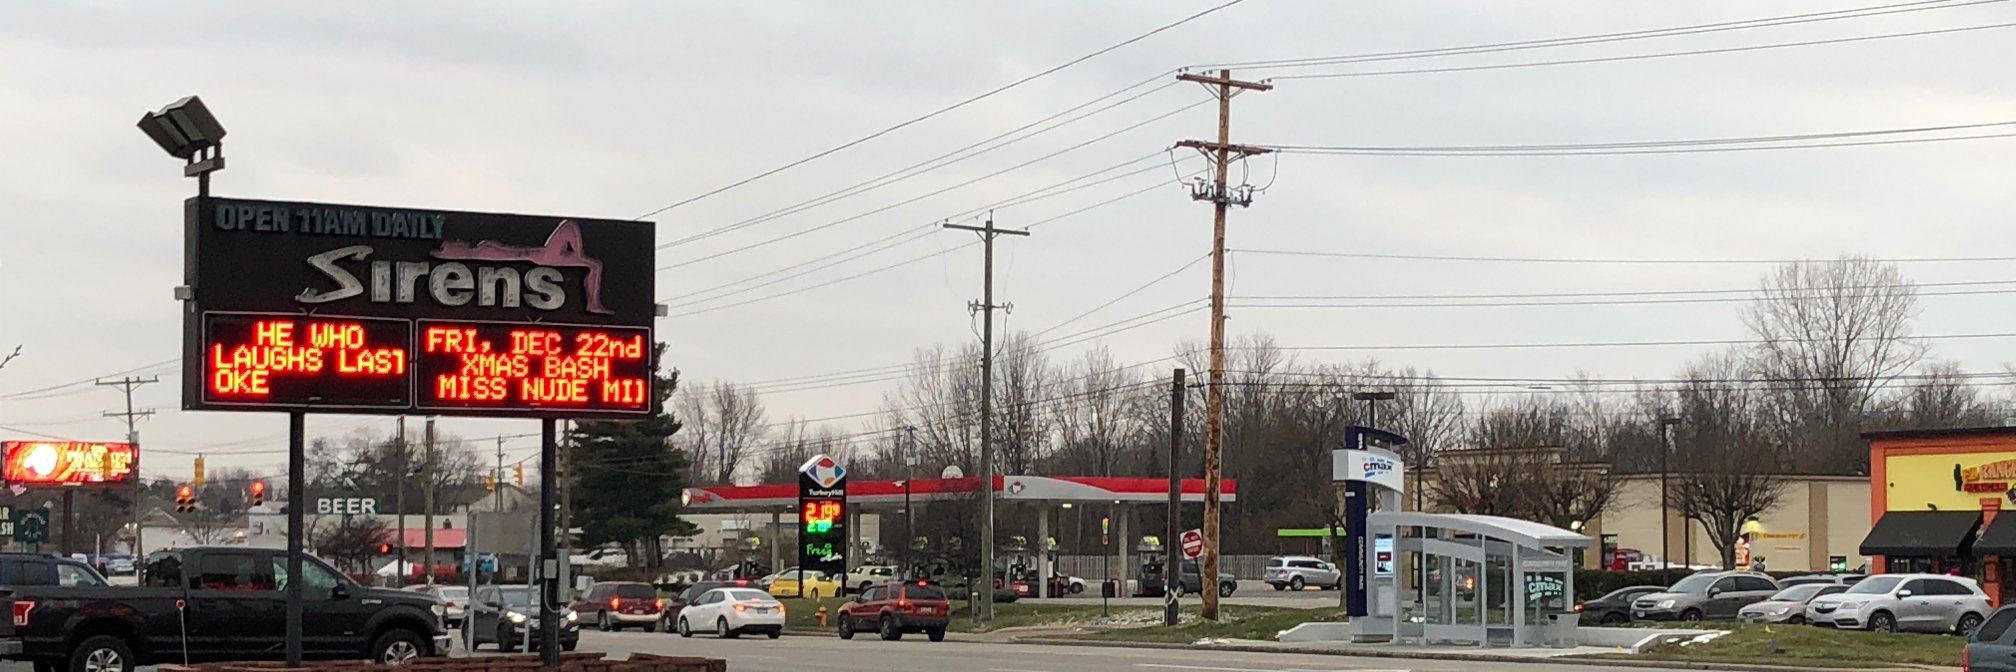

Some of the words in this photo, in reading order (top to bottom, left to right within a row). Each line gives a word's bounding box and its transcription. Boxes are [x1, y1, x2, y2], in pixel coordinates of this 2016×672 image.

[215, 203, 290, 232] OPEN
[296, 207, 366, 236] 11AM
[372, 211, 446, 239] DAILY
[295, 245, 566, 310] Sirens
[256, 321, 294, 347] HE
[310, 322, 363, 349] WHO
[426, 327, 491, 353] FRI,
[511, 330, 562, 355] DEC
[576, 332, 642, 358] 22nd
[214, 343, 324, 373] LAUGHS
[461, 353, 529, 378] XMAS
[544, 355, 611, 380] BASH
[214, 368, 269, 394] OKE
[437, 374, 507, 400] MISS
[521, 377, 588, 402] NUDE
[1363, 462, 1392, 472] cmax
[317, 497, 376, 515] BEER
[1528, 581, 1562, 593] cmax
